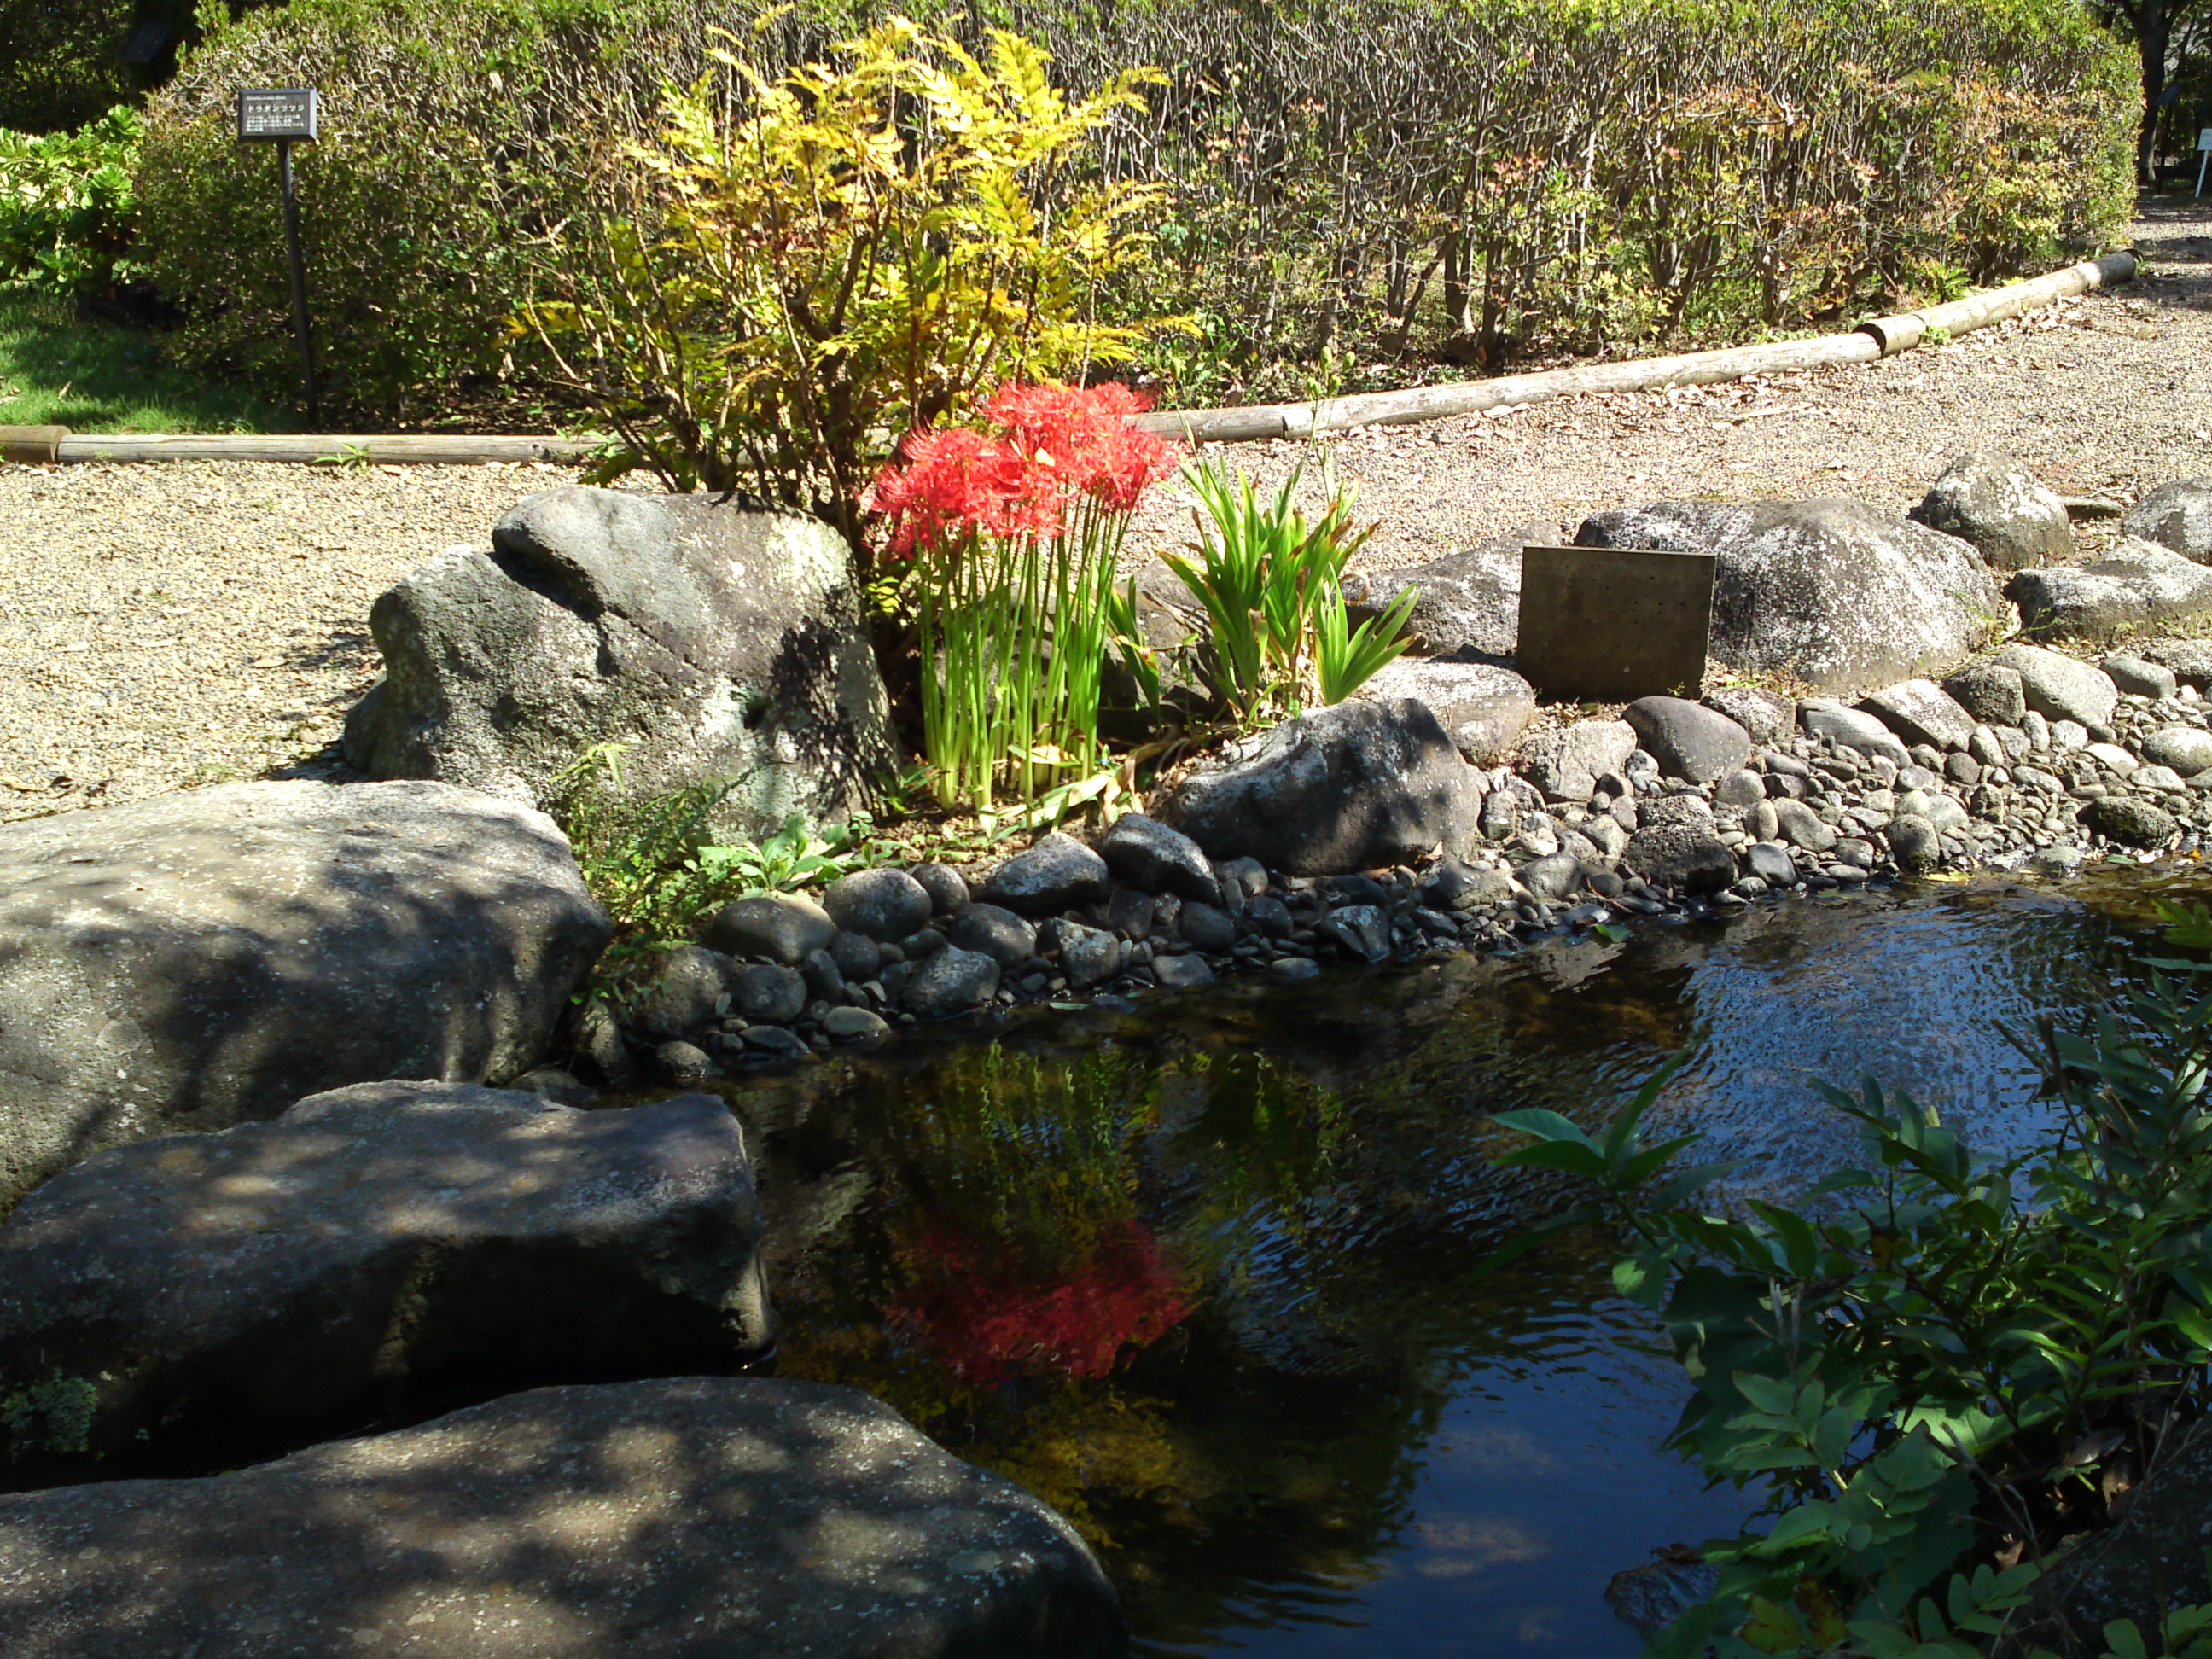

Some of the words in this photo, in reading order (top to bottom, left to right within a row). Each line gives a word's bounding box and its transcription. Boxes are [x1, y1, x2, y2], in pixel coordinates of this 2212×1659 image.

[248, 104, 305, 113] ドウダンツツジ
